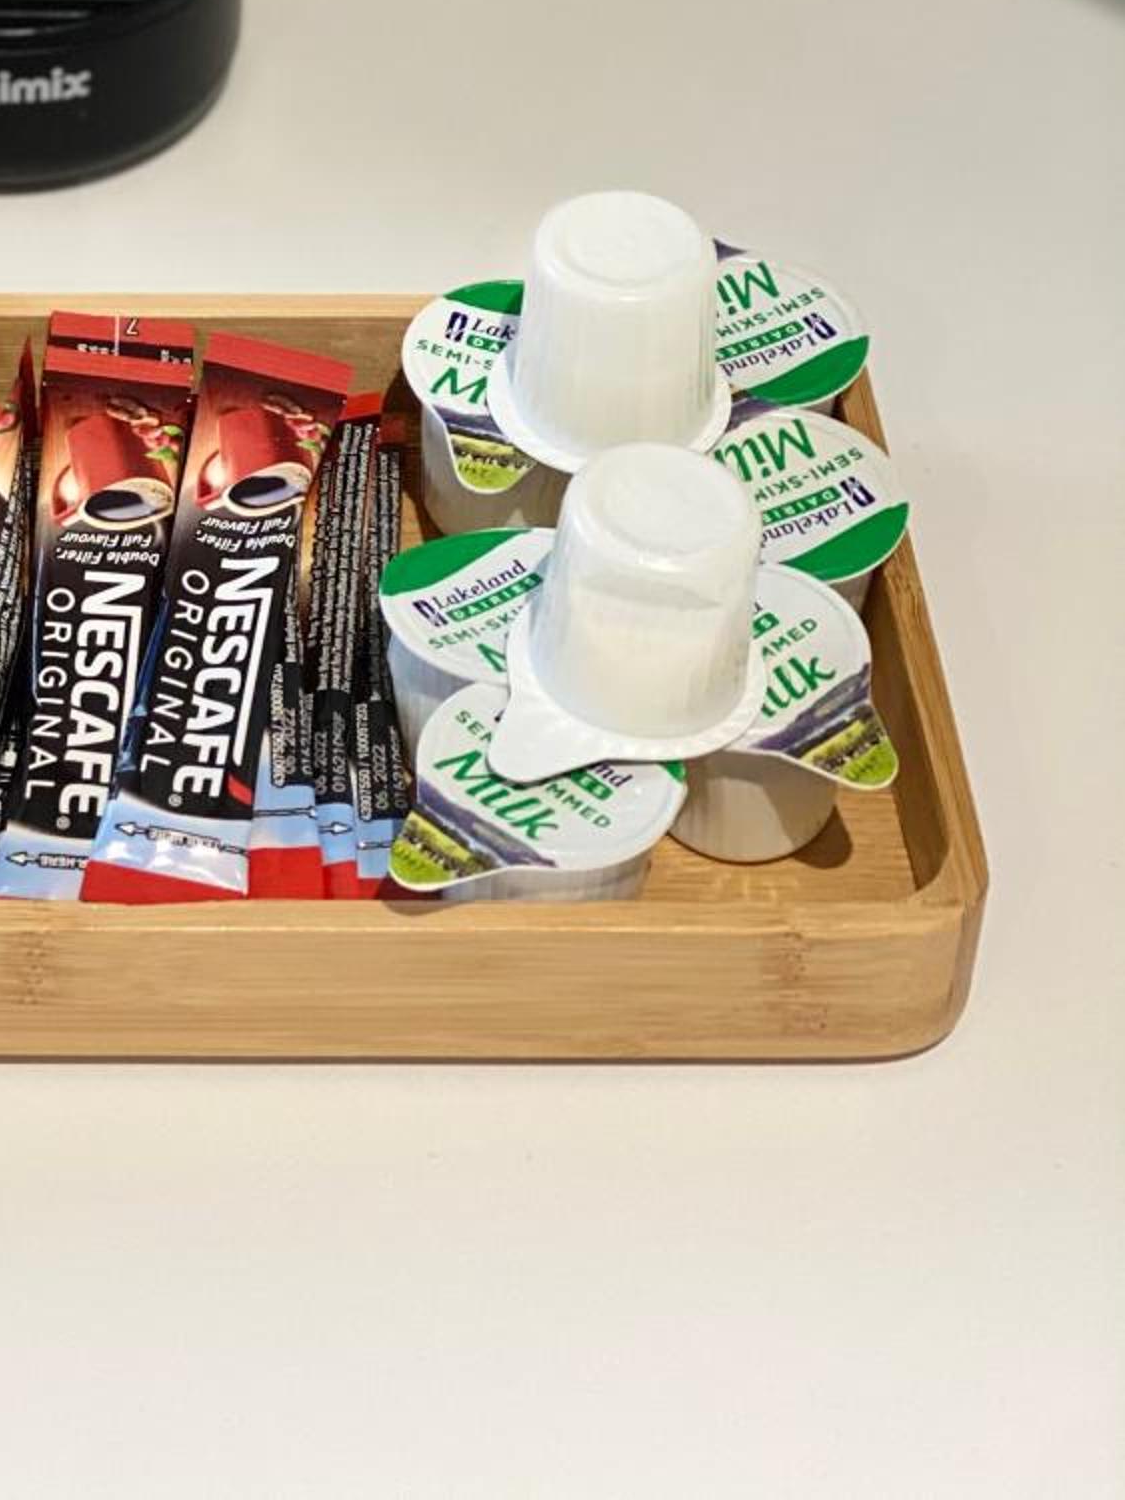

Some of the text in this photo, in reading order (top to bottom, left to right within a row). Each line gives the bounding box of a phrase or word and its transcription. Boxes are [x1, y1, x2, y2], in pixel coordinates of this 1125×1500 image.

[720, 332, 818, 377] Lakeland
[59, 531, 153, 548] Full Flavour
[200, 515, 293, 535] Full Flavour
[106, 551, 160, 567] Double
[432, 559, 527, 610] Lakeland
[25, 587, 76, 800] ORIGINAL
[140, 569, 210, 773] ORIGINAL
[433, 750, 559, 841] Milk
